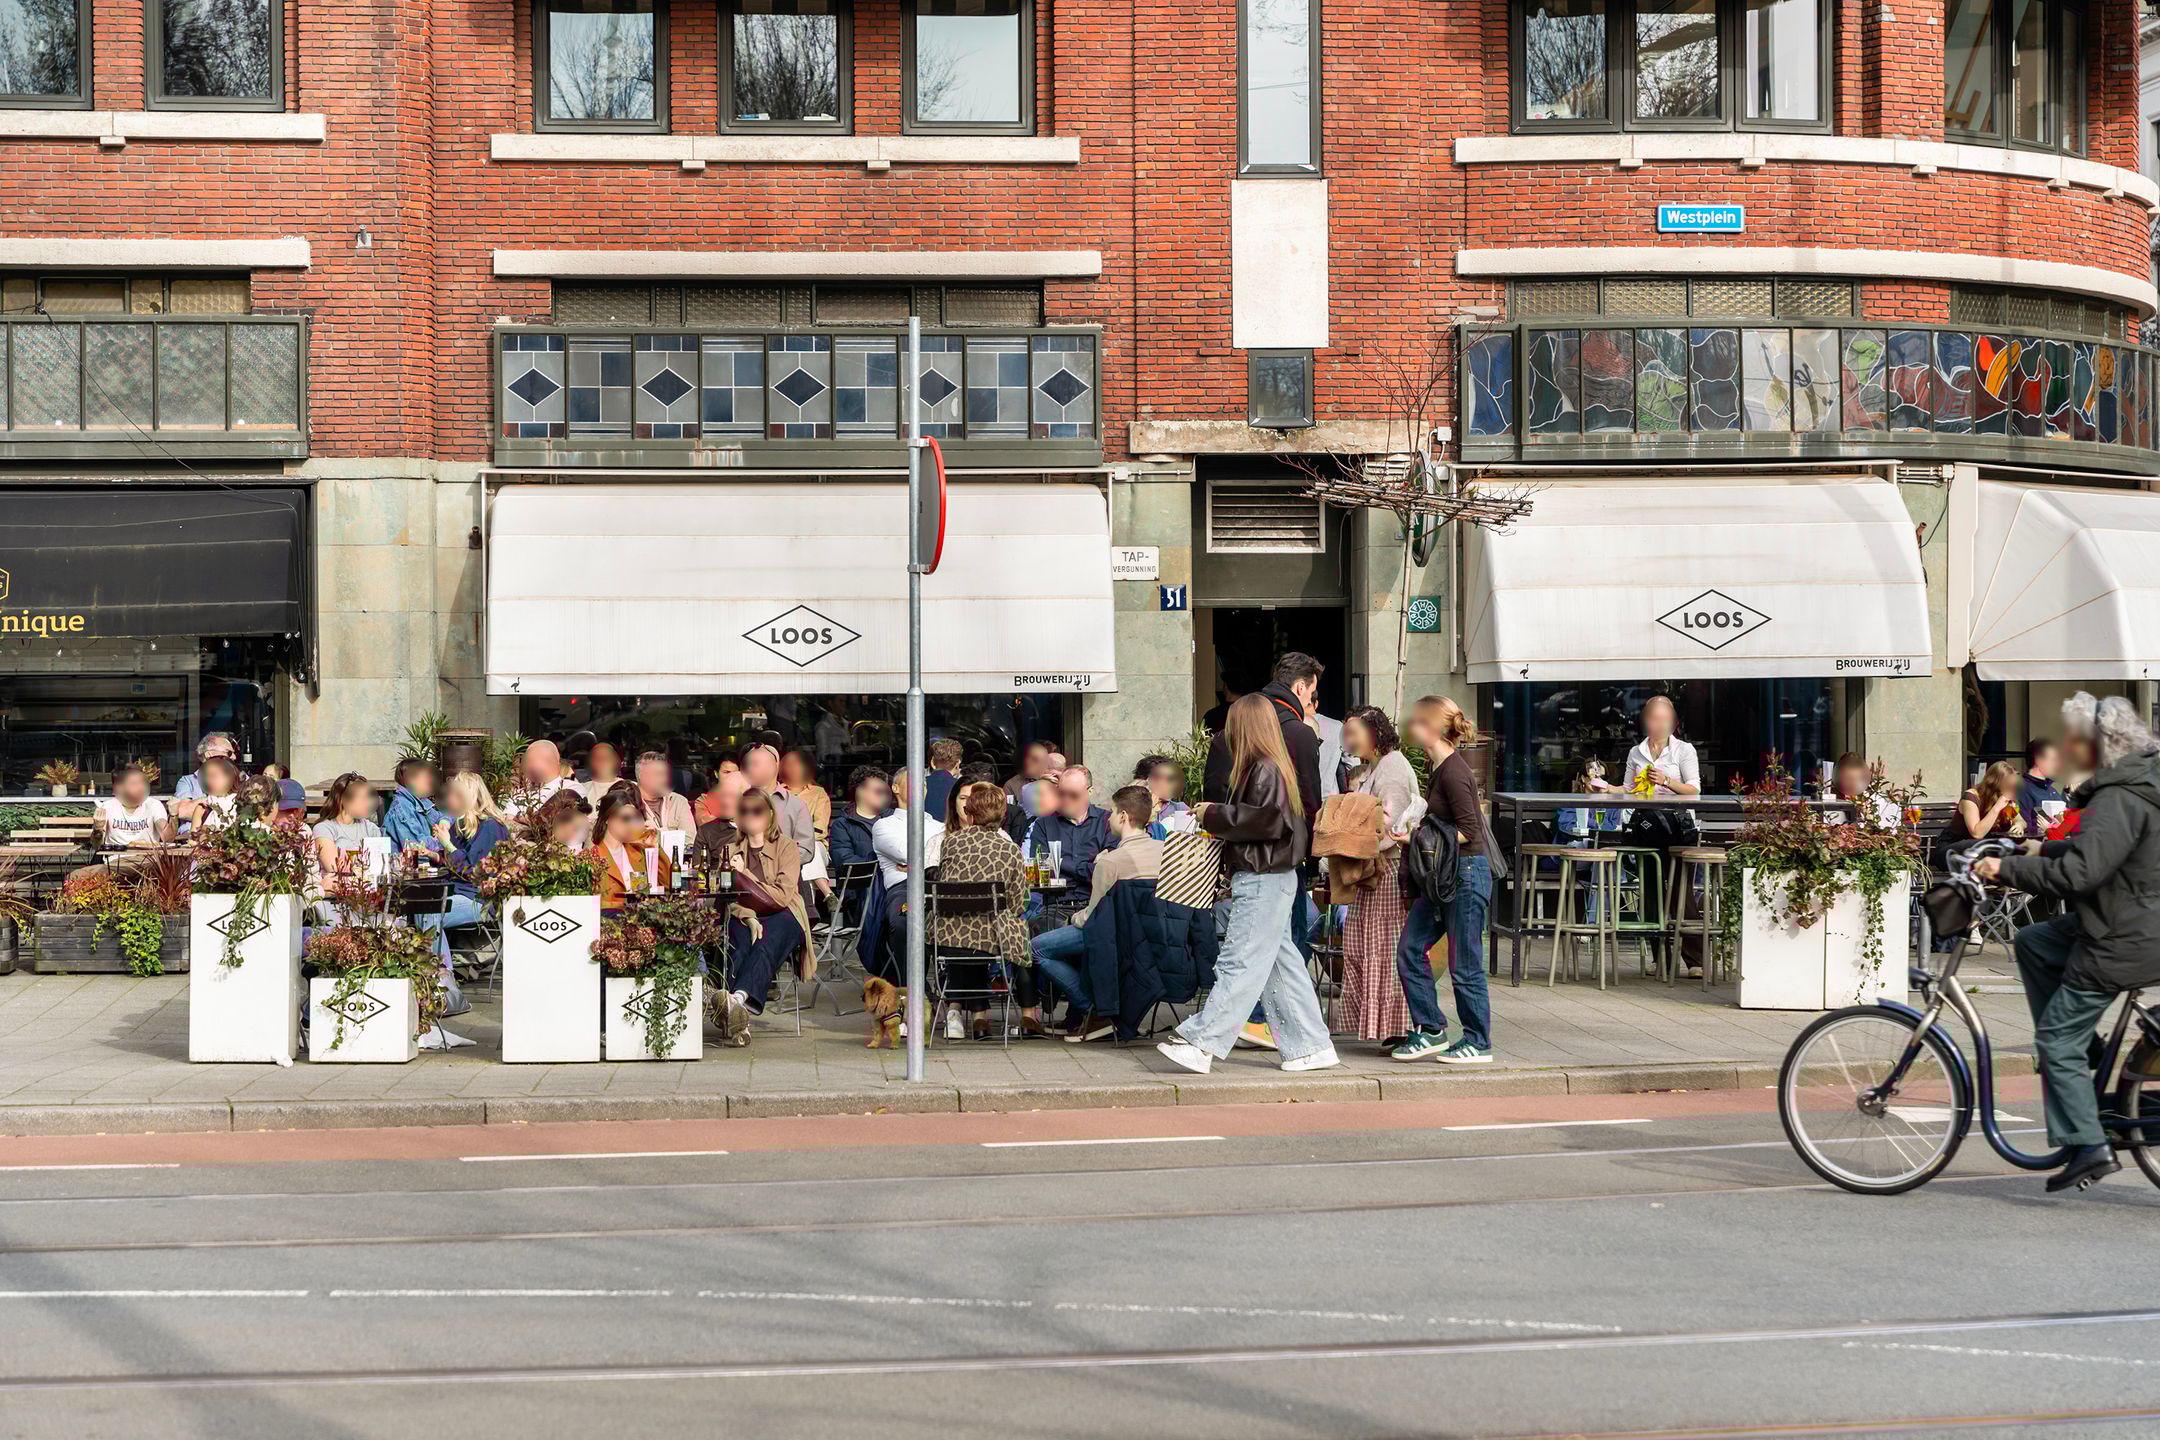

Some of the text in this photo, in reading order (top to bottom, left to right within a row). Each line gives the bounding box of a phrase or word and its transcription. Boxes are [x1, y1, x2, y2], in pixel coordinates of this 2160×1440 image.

[1667, 210, 1736, 226] Westplein
[1122, 552, 1149, 562] TAP-
[1167, 587, 1181, 608] 51
[0, 609, 85, 638] nique
[1683, 611, 1744, 628] LOOS
[771, 627, 833, 644] LOOS
[1835, 659, 1893, 670] BROUWERIJ
[1014, 675, 1072, 686] BROUWERIJ
[533, 921, 567, 931] LOOS
[637, 1001, 669, 1011] LO
